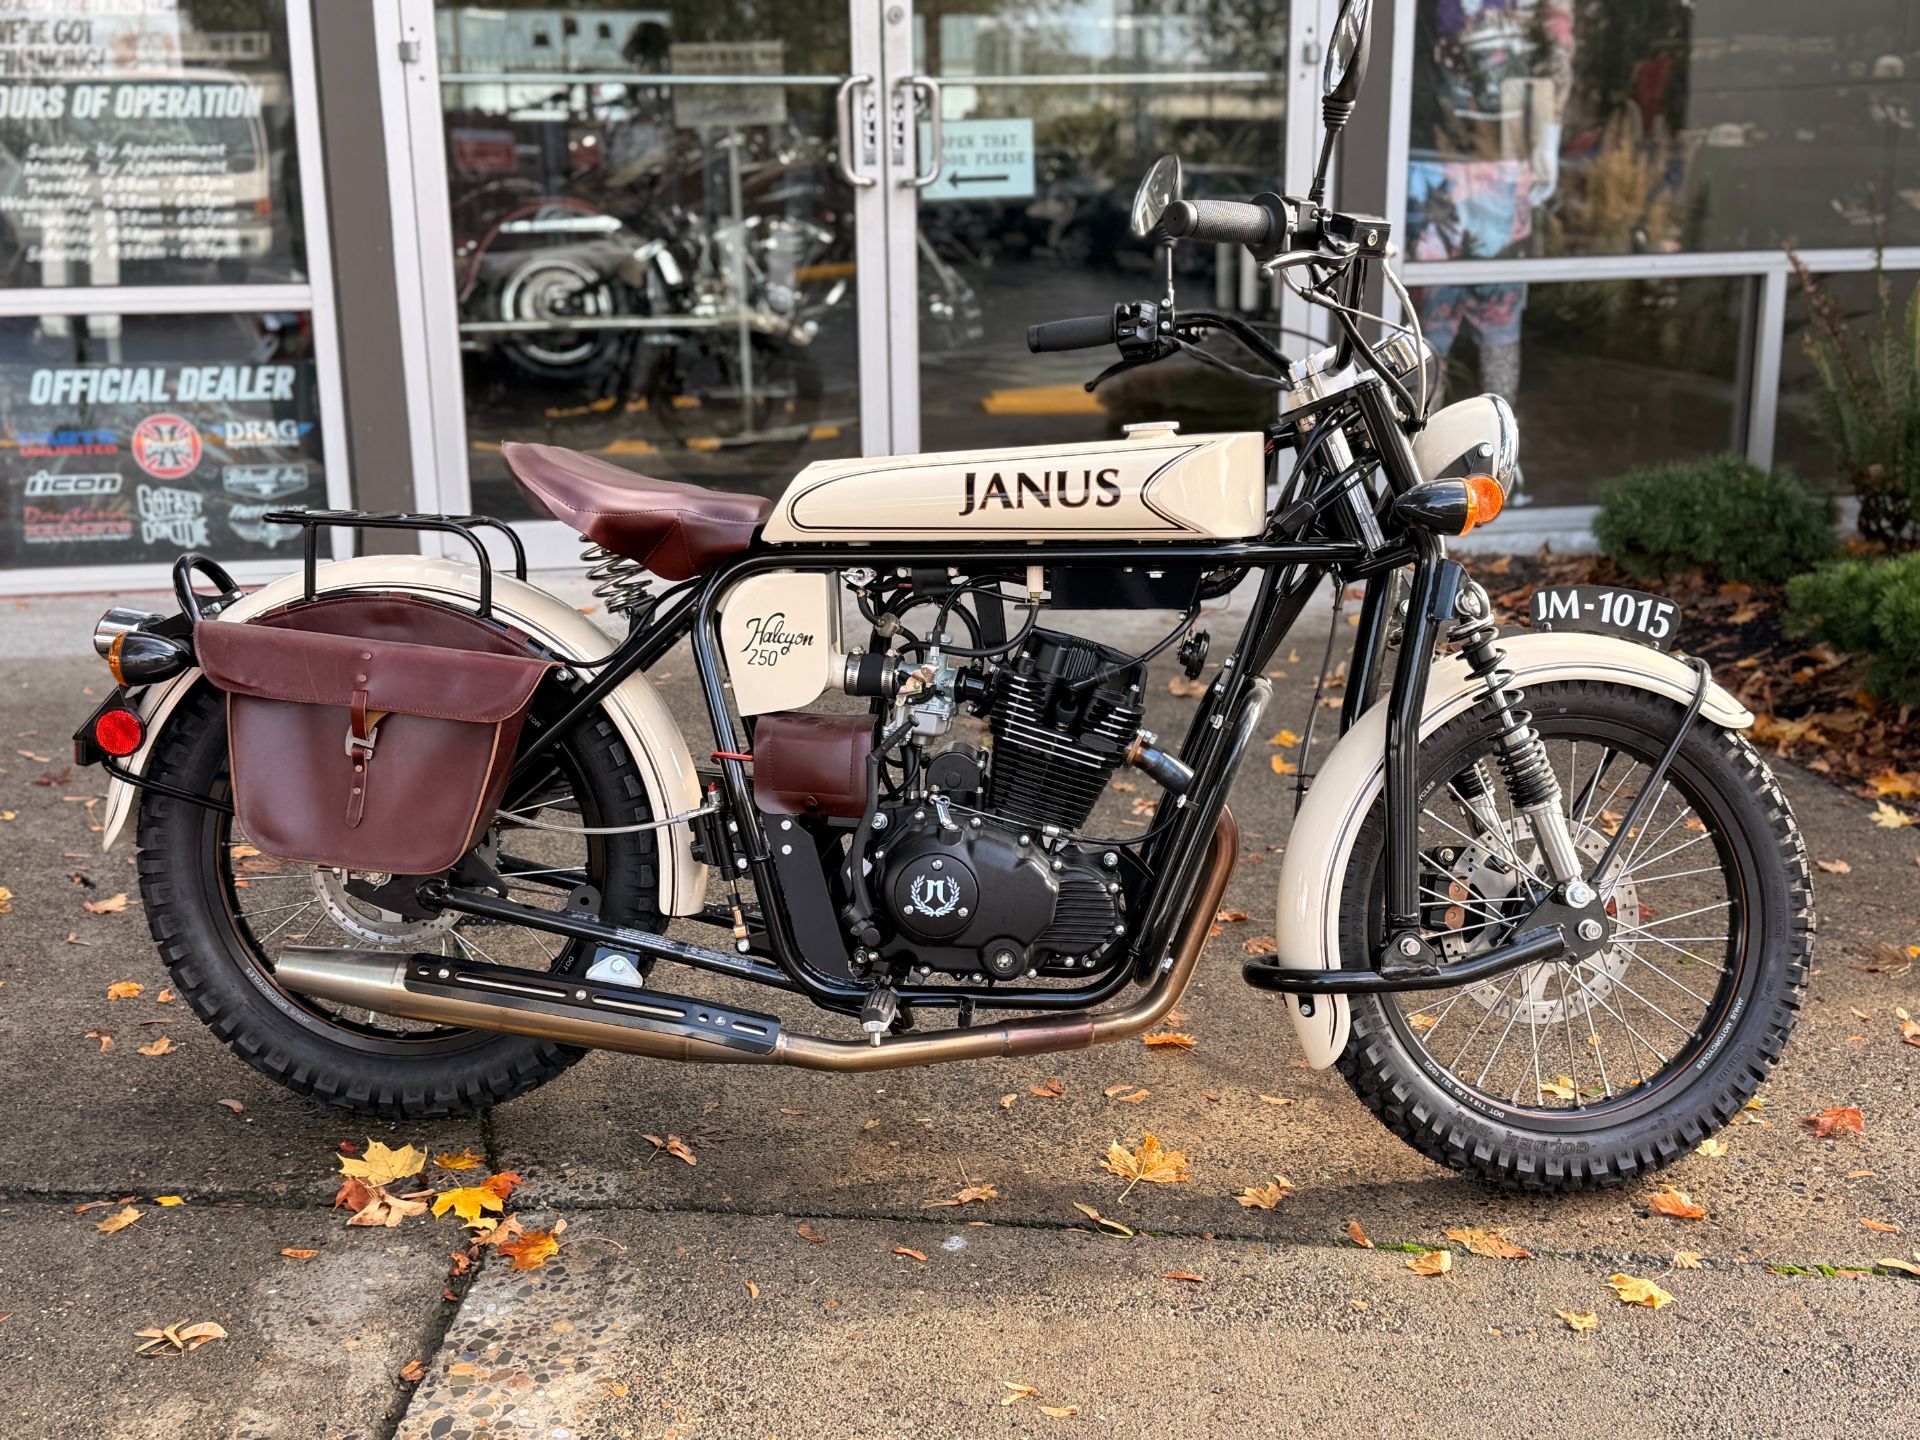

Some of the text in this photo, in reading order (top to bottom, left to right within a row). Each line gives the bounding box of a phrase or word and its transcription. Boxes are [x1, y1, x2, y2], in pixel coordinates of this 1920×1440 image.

[53, 20, 92, 44] GOT
[71, 85, 111, 118] OF
[114, 84, 263, 119] OPERATION
[982, 133, 1018, 147] THAT
[975, 152, 1025, 166] PLEASE
[30, 365, 296, 405] OFFICIAL DEALER
[224, 420, 300, 439] DRAG
[958, 468, 1121, 516] JANUS
[1537, 589, 1674, 638] JM-1015
[739, 612, 814, 656] Halcyon
[747, 648, 779, 666] 250
[1729, 996, 1744, 1020] JANUS
[1696, 1021, 1733, 1070] MOTORCYCLES
[1489, 1109, 1505, 1119] DOT
